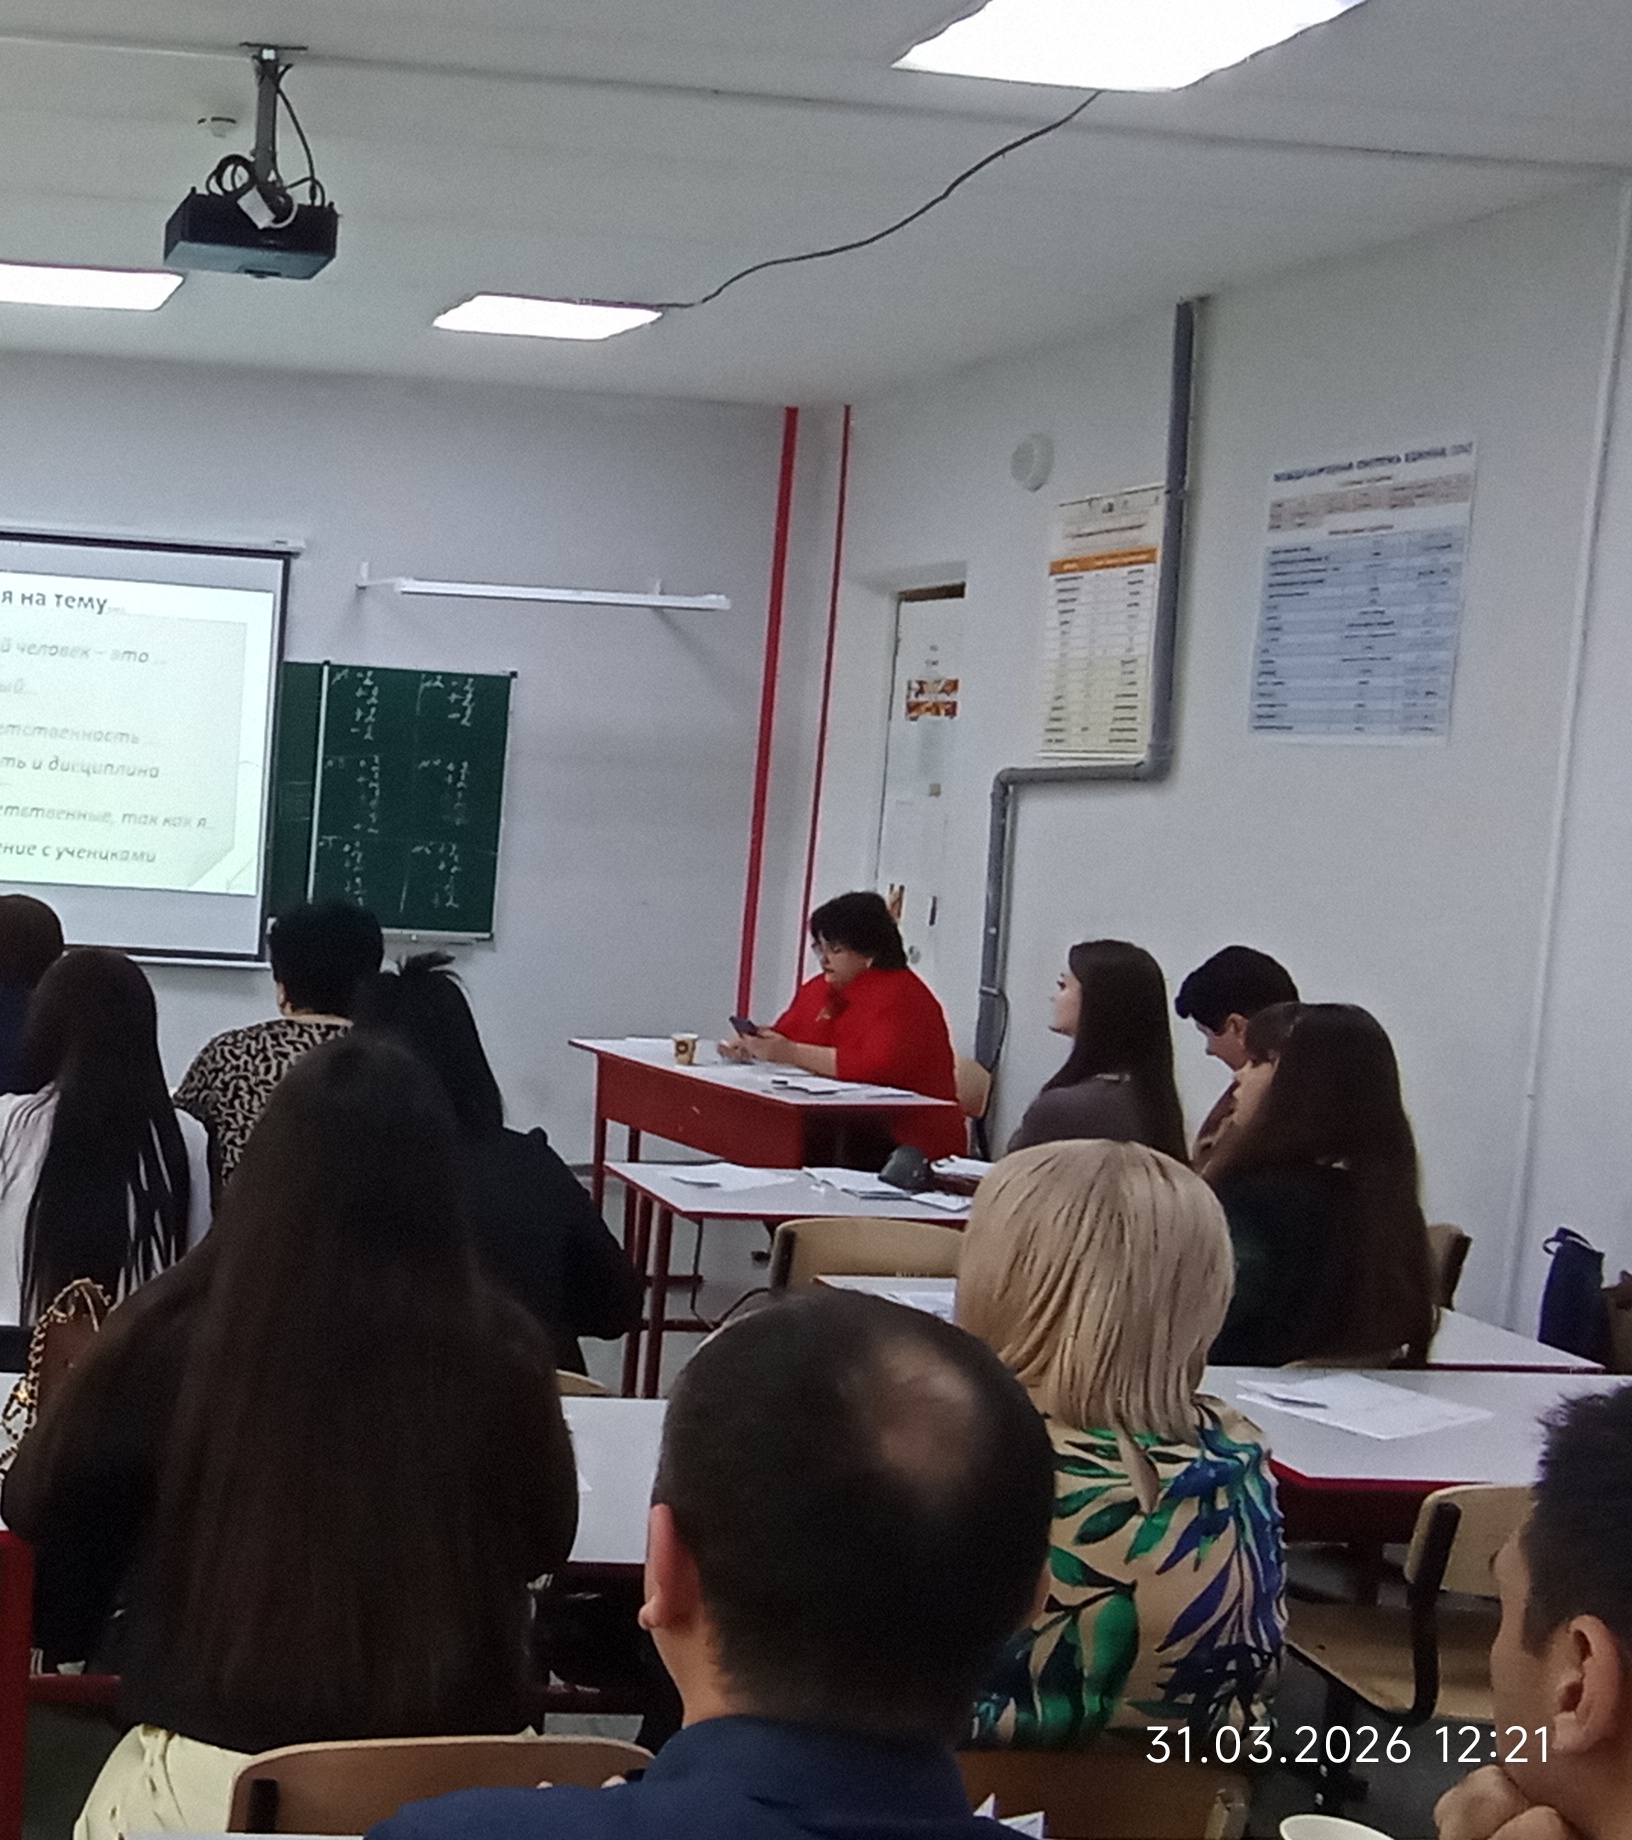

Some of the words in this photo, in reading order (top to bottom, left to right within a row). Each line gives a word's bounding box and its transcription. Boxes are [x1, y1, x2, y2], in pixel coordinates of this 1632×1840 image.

[21, 592, 46, 606] на
[17, 642, 91, 659] человек
[32, 758, 43, 770] и
[48, 755, 160, 778] дисциплина
[121, 812, 158, 826] так
[42, 845, 51, 857] с
[55, 845, 156, 863] учениками
